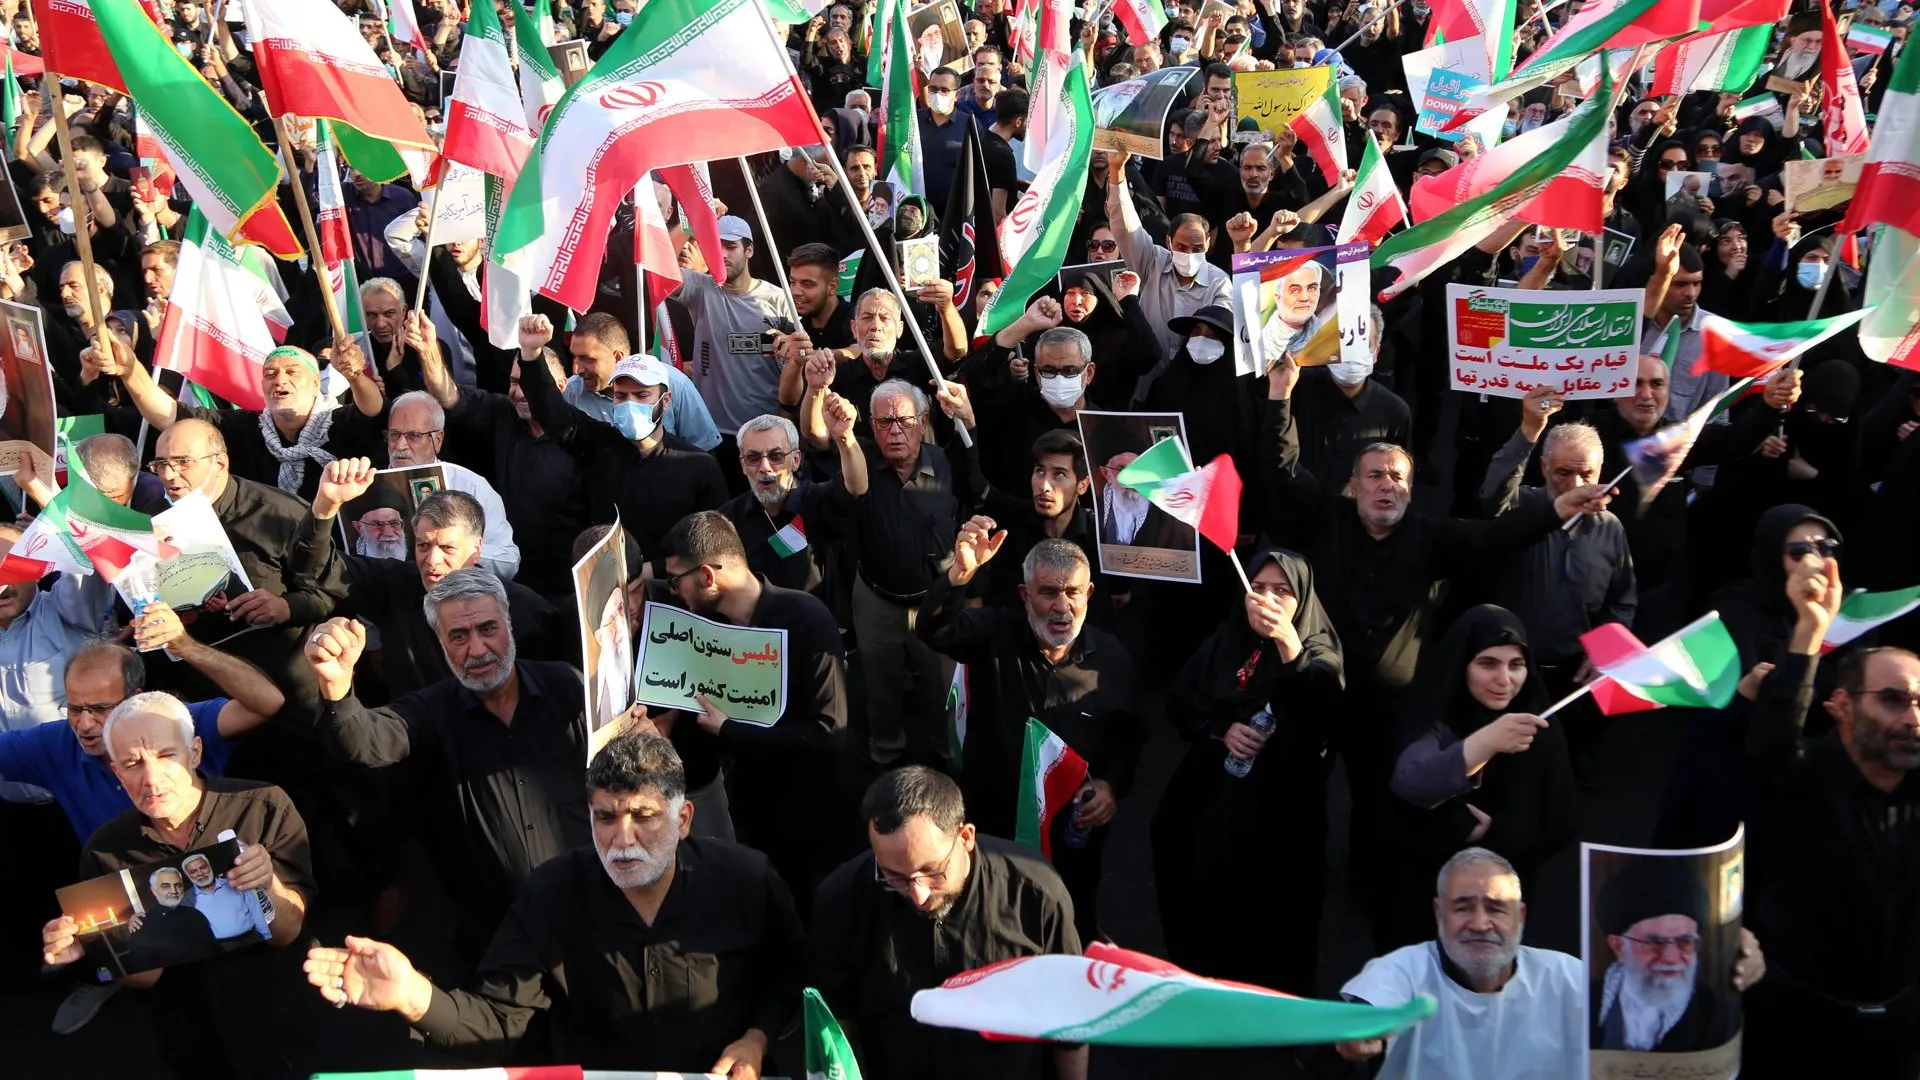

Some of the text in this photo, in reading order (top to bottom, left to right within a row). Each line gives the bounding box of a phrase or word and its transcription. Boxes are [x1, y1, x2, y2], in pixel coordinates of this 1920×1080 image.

[1261, 98, 1287, 117] رسول
[1287, 101, 1292, 116] یا
[1426, 98, 1457, 112] DOWN
[1358, 314, 1367, 341] یا
[1510, 303, 1573, 331] ایران
[1561, 316, 1635, 348] انقلاب
[1455, 349, 1492, 364] است
[1555, 354, 1585, 374] یک
[1590, 351, 1628, 373] قیام
[1456, 367, 1510, 390] قدرتها
[1555, 376, 1602, 396] مقابل
[1607, 376, 1631, 394] در
[650, 621, 779, 668] پلیس ستون اصلی
[645, 671, 777, 709] امنیت کشور است
